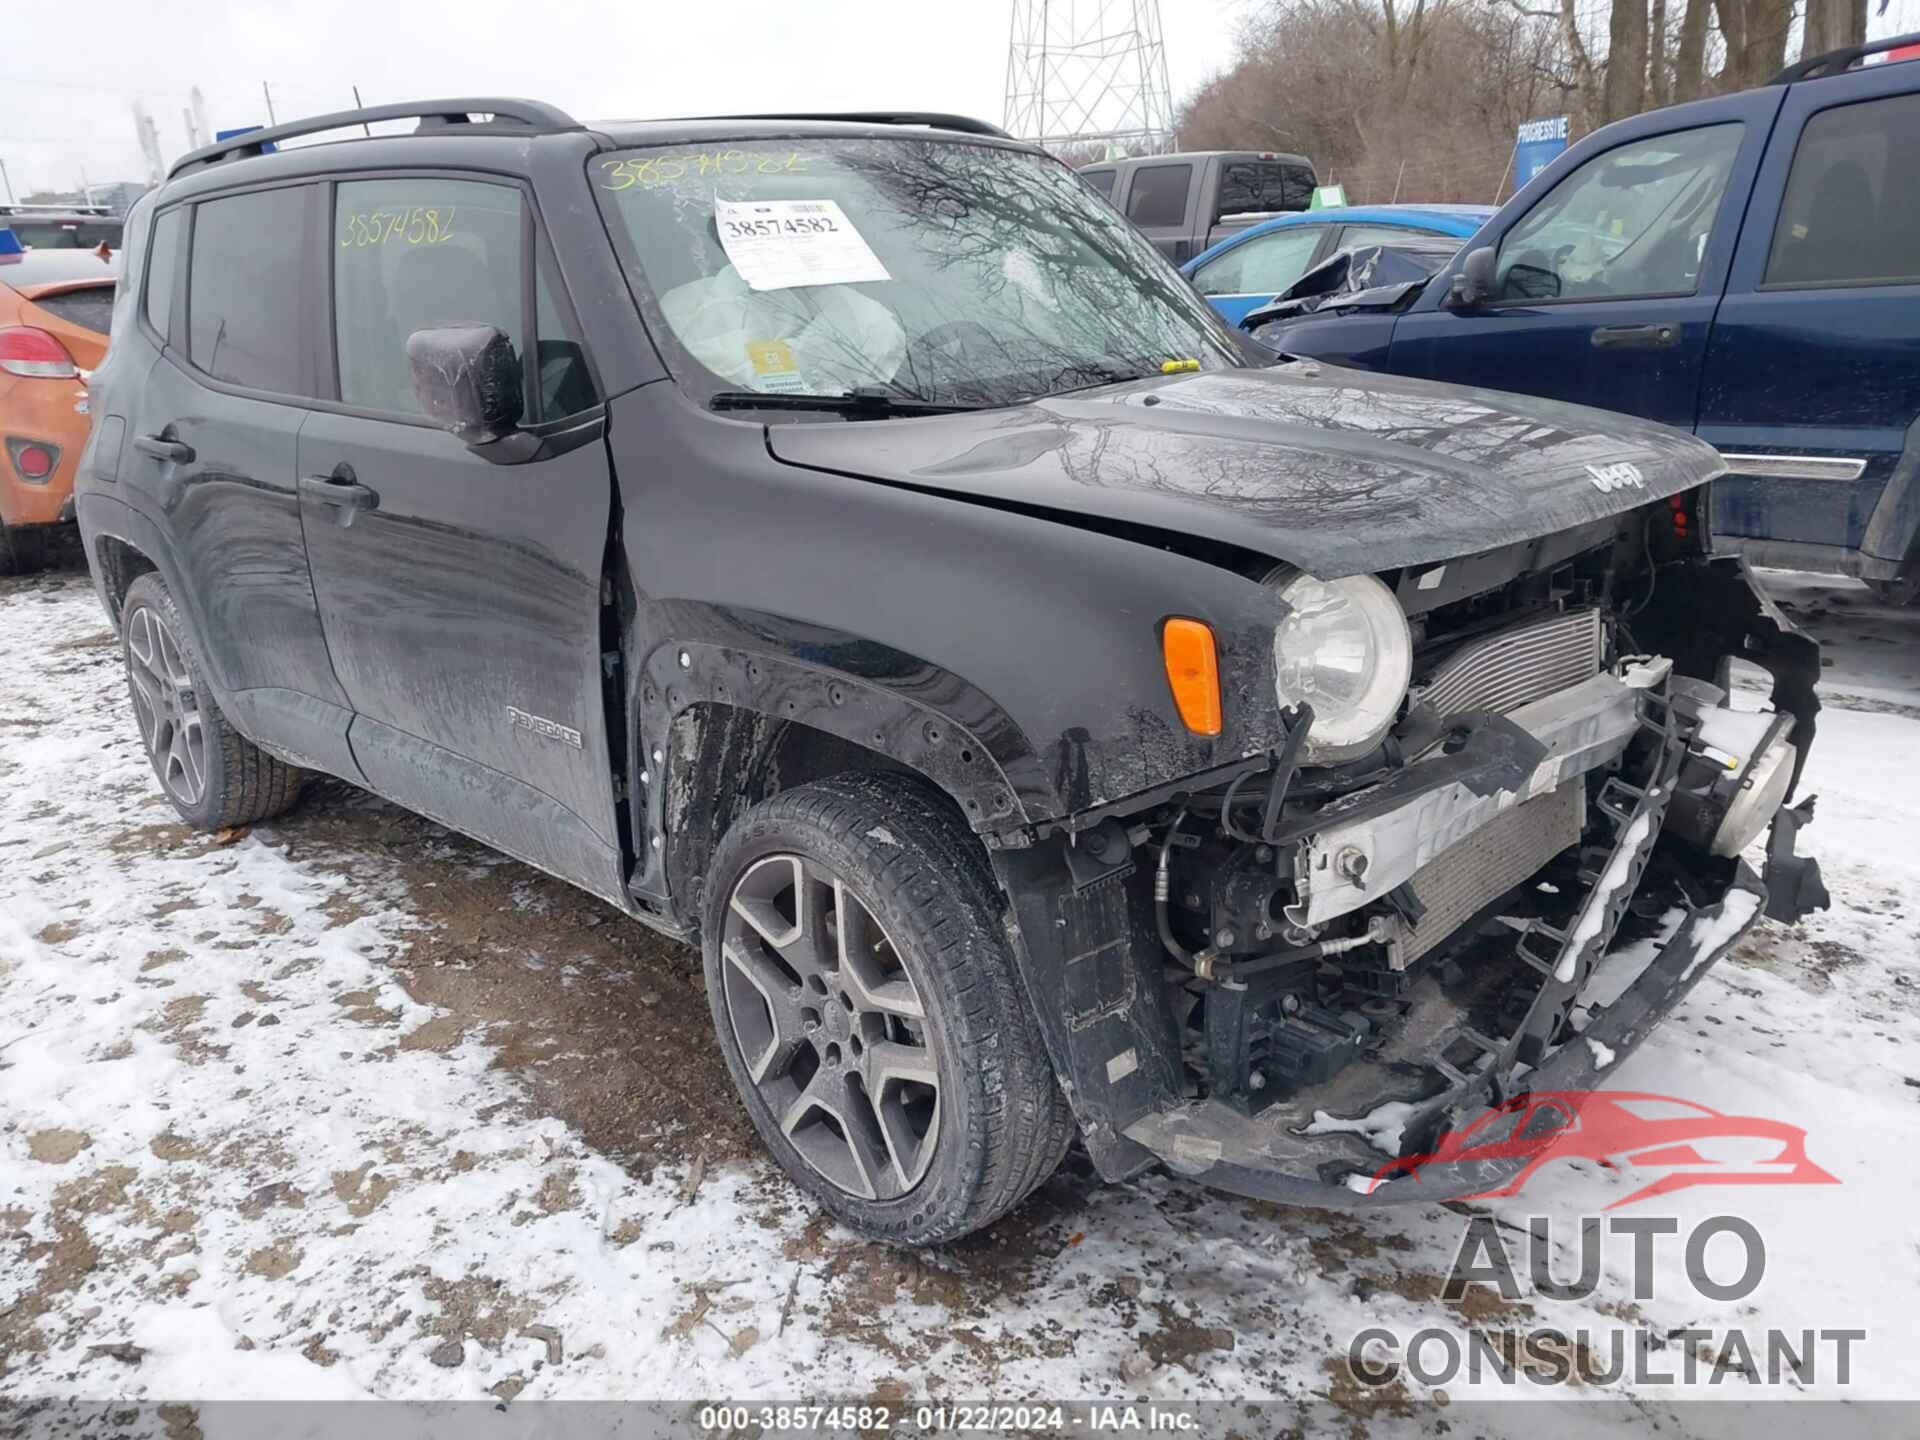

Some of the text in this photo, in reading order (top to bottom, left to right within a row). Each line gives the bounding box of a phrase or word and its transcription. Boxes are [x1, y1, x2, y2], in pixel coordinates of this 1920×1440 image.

[725, 217, 839, 238] 38574582
[1583, 461, 1645, 493] Jeep
[506, 705, 582, 750] RENEGADE
